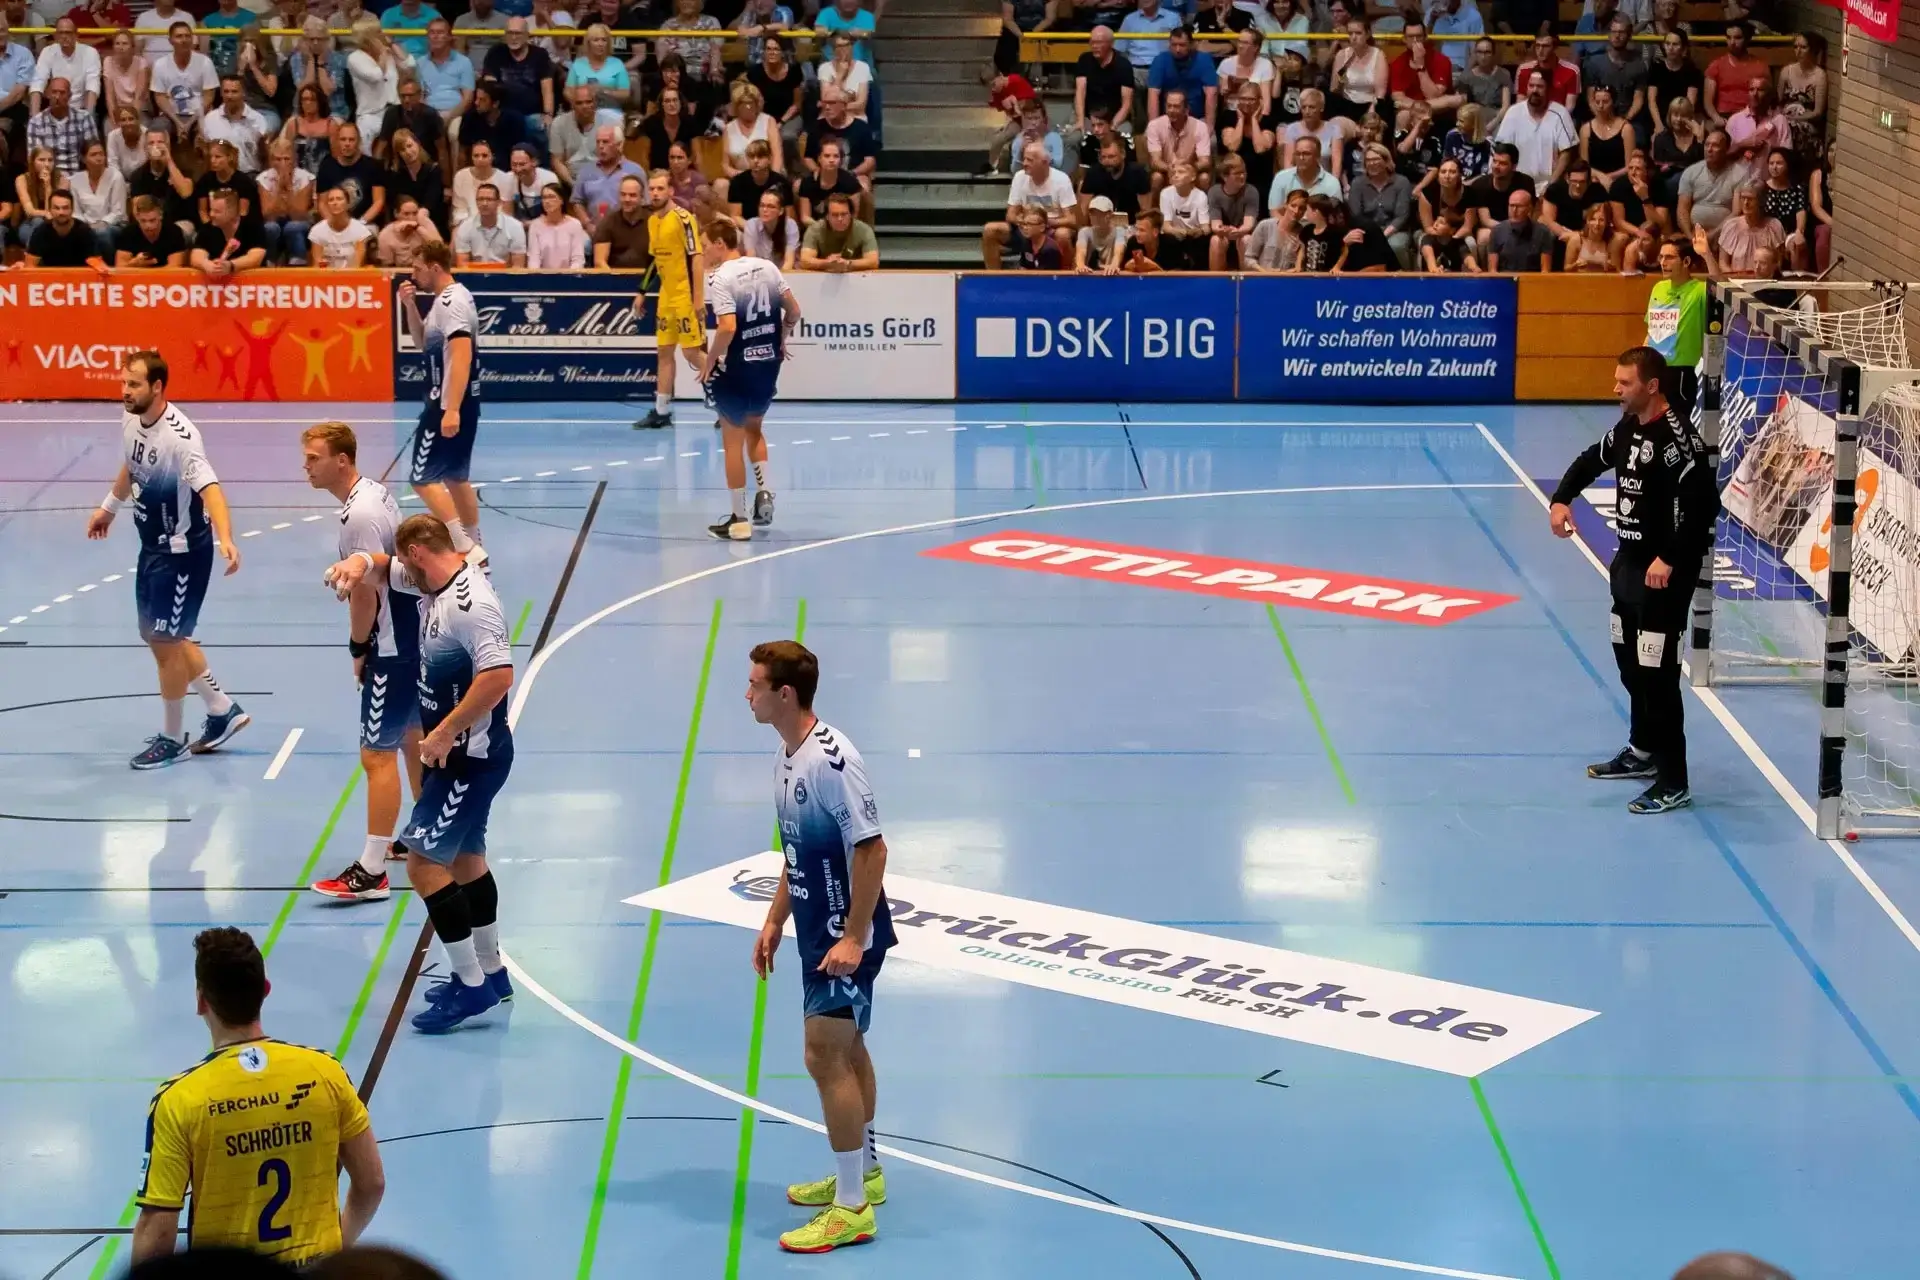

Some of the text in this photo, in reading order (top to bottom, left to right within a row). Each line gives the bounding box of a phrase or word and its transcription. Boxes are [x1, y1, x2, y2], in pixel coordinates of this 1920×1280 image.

[29, 284, 123, 308] ECHTE
[133, 285, 383, 309] SPORTSFREUNDE.
[745, 283, 772, 322] 24
[509, 323, 548, 335] von
[558, 301, 640, 336] Melle
[1316, 300, 1498, 322] Wir gestalten Städte
[1649, 311, 1677, 321] BOSCH
[790, 317, 874, 338] homas
[883, 317, 936, 338] Görß
[1026, 318, 1215, 358] DSK BIG
[1282, 328, 1497, 348] Wir schaffen Wohnraum
[33, 344, 158, 370] VIACT
[1283, 358, 1498, 378] Wir entwickeln Zukunft
[559, 366, 657, 383] Weinhandelsha
[132, 440, 145, 464] 18
[1619, 530, 1642, 540] LOTTO
[969, 539, 1482, 618] CITTI-PARK
[822, 858, 834, 911] STADTWERKE
[959, 945, 1172, 993] Online Casino
[1176, 988, 1304, 1019] Für SH
[208, 1092, 280, 1116] FERCHAU
[225, 1120, 313, 1156] SCHRÖTER
[257, 1158, 292, 1242] 2
